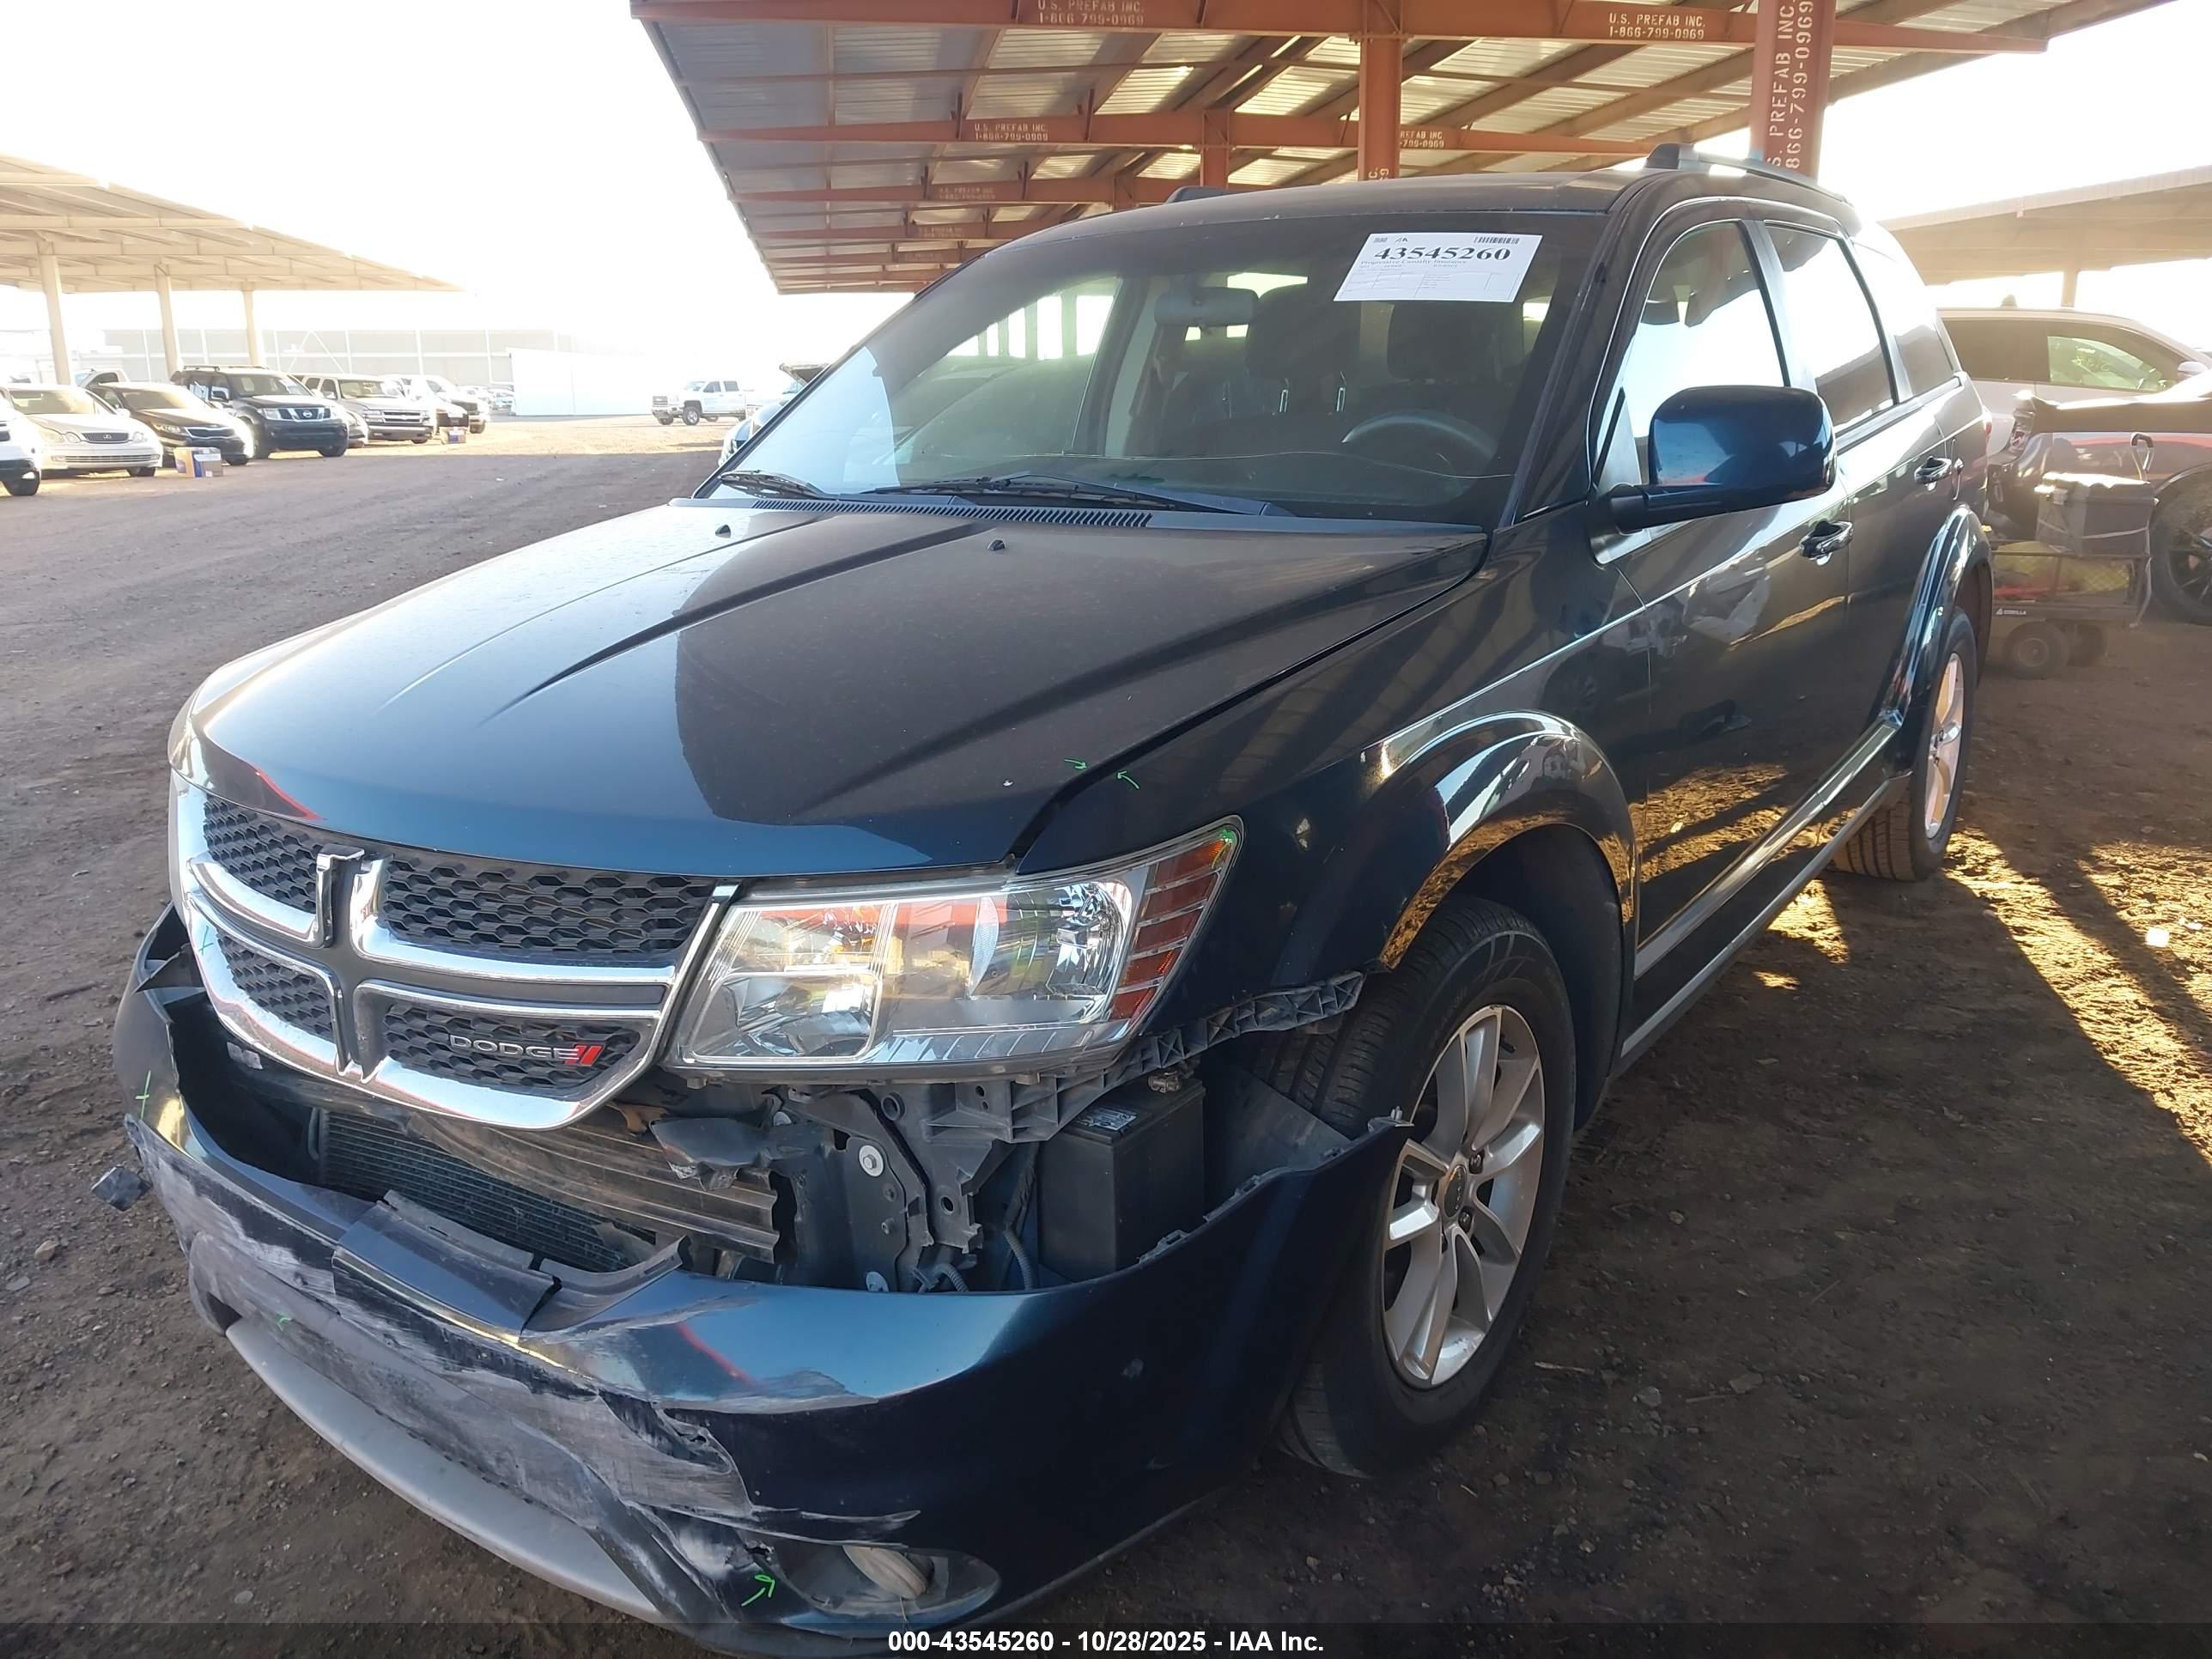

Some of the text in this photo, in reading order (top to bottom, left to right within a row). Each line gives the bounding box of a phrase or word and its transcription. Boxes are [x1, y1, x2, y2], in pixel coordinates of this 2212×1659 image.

[1609, 12, 1705, 27] U.S. PREFAB INC.
[1609, 26, 1705, 40] 1-866-799-0969
[1785, 1, 1814, 169] 866-799-0969
[1769, 52, 1791, 137] PREFAB
[1400, 130, 1426, 138] REFAB
[1374, 246, 1511, 260] 43545260
[449, 1034, 580, 1060] DODGE
